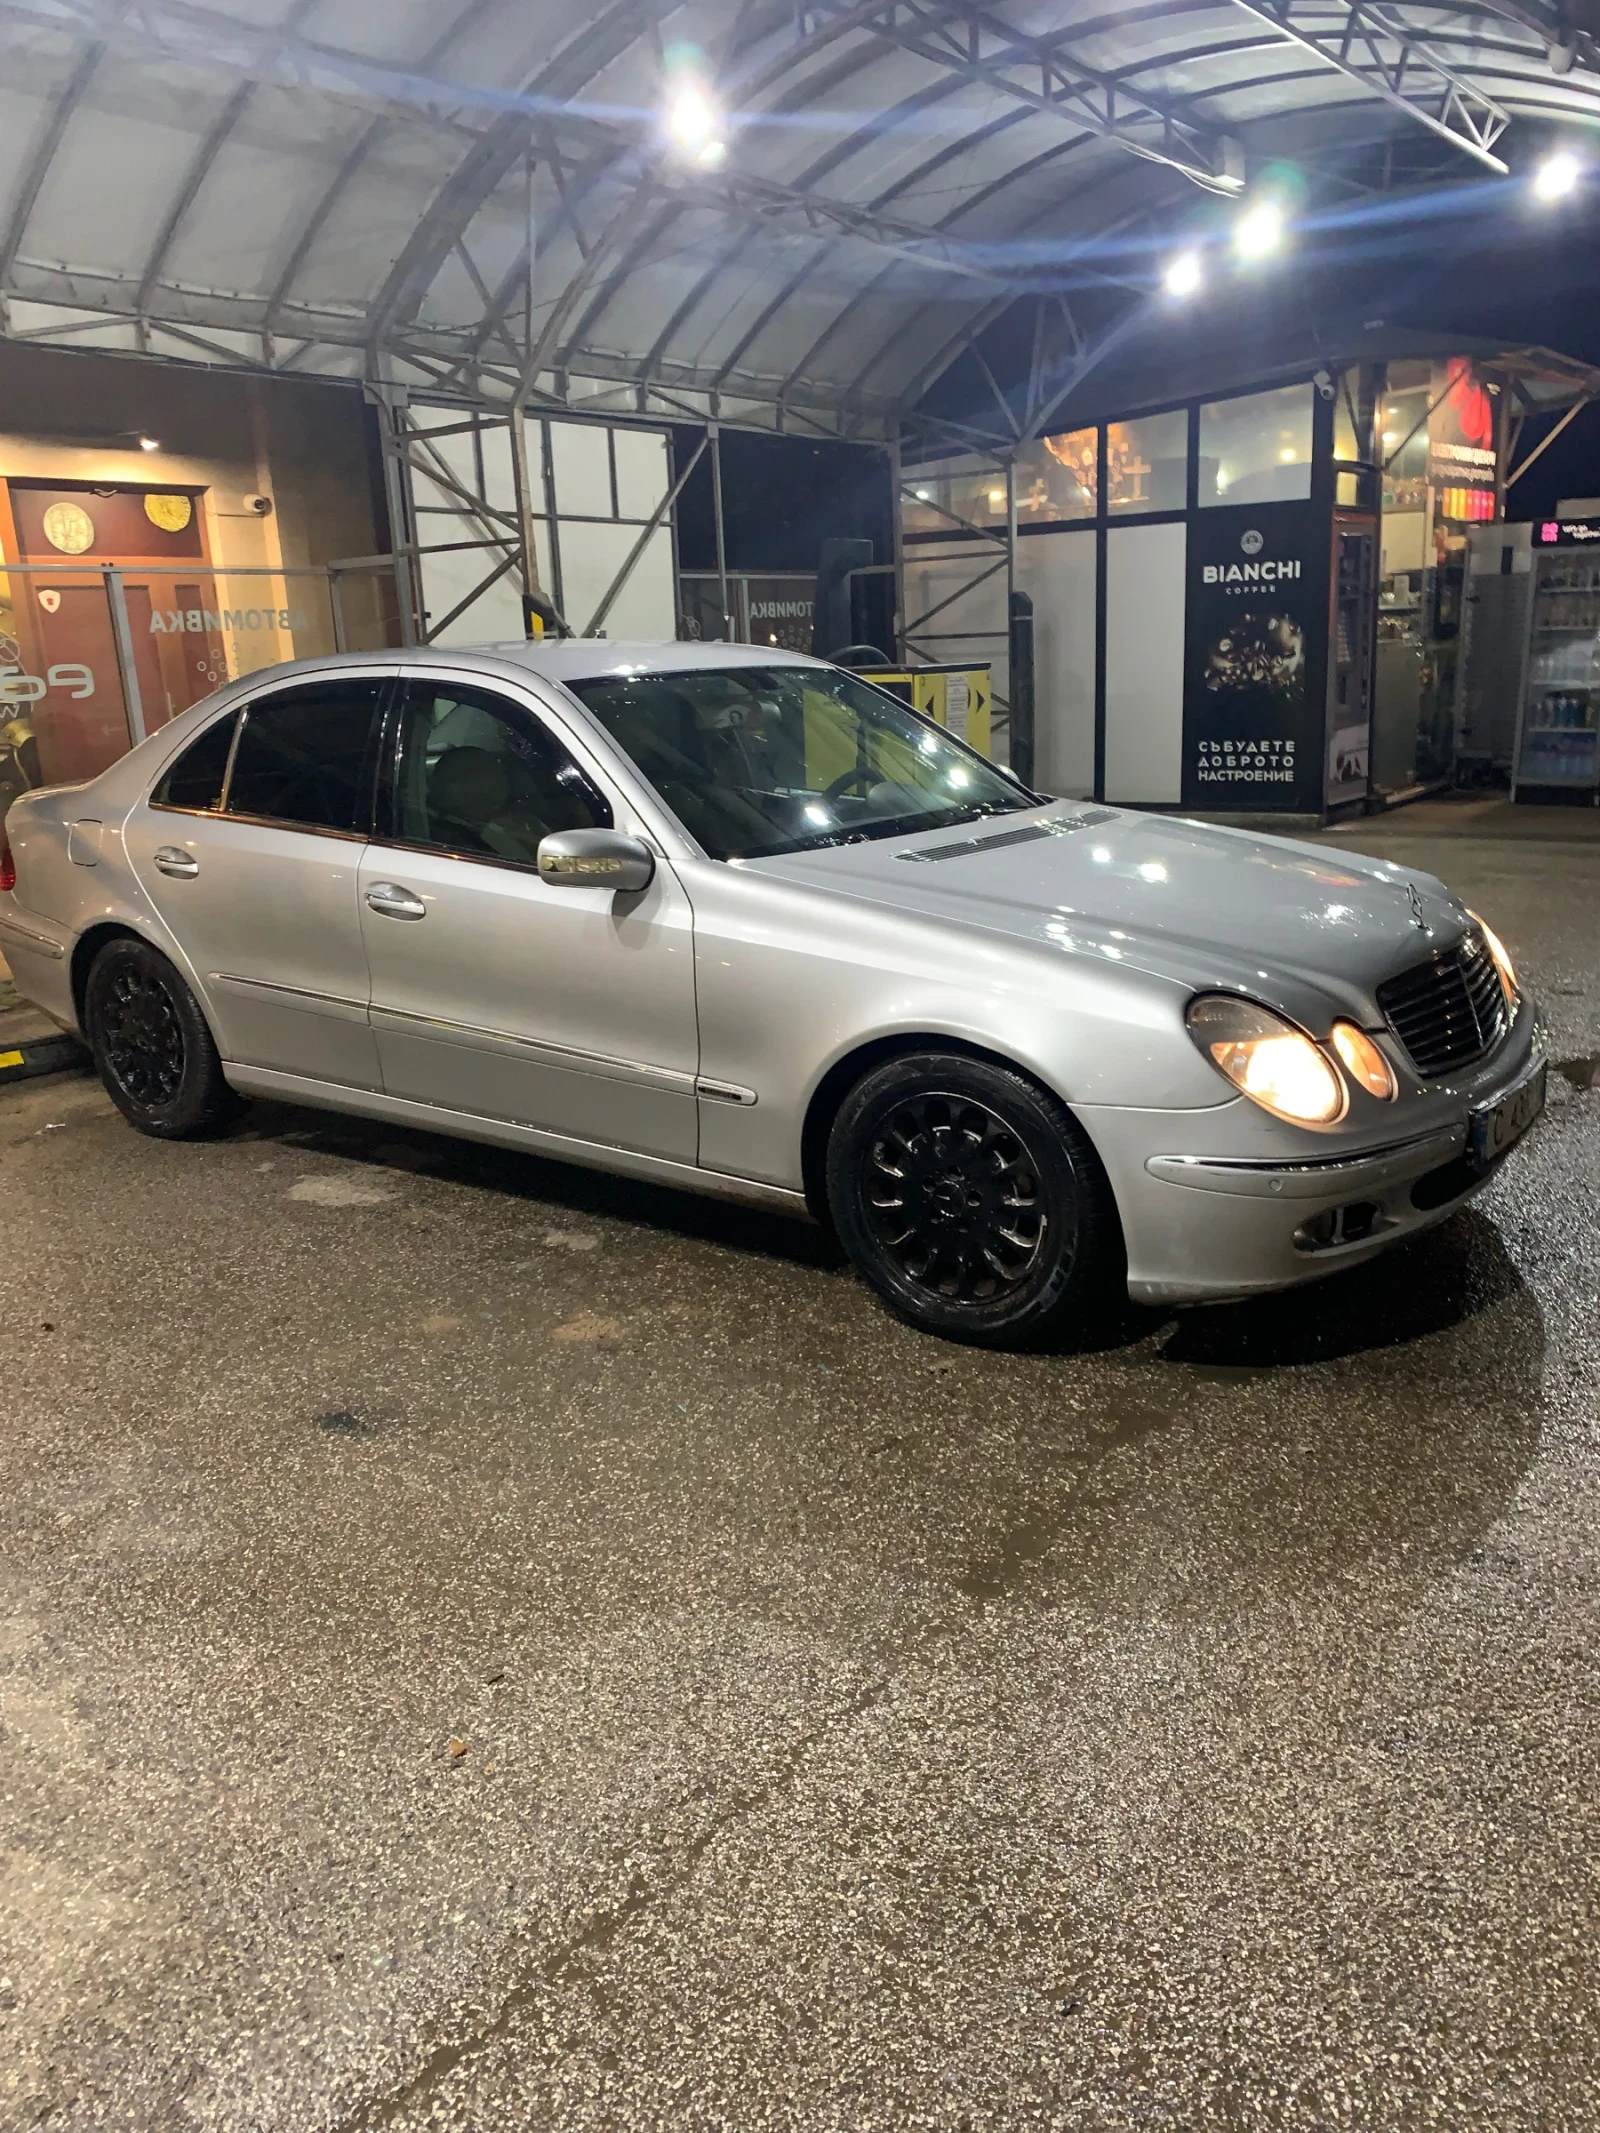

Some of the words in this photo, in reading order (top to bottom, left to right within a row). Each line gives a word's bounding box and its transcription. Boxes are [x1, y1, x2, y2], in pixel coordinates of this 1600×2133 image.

[1203, 560, 1300, 583] BIANCHI
[1226, 585, 1276, 595] COFFEE
[1198, 740, 1295, 753] СЪБУДЕТЕ
[1198, 755, 1294, 768] ДОБРОТО
[1198, 770, 1294, 782] НАСТРОЕНИЕ
